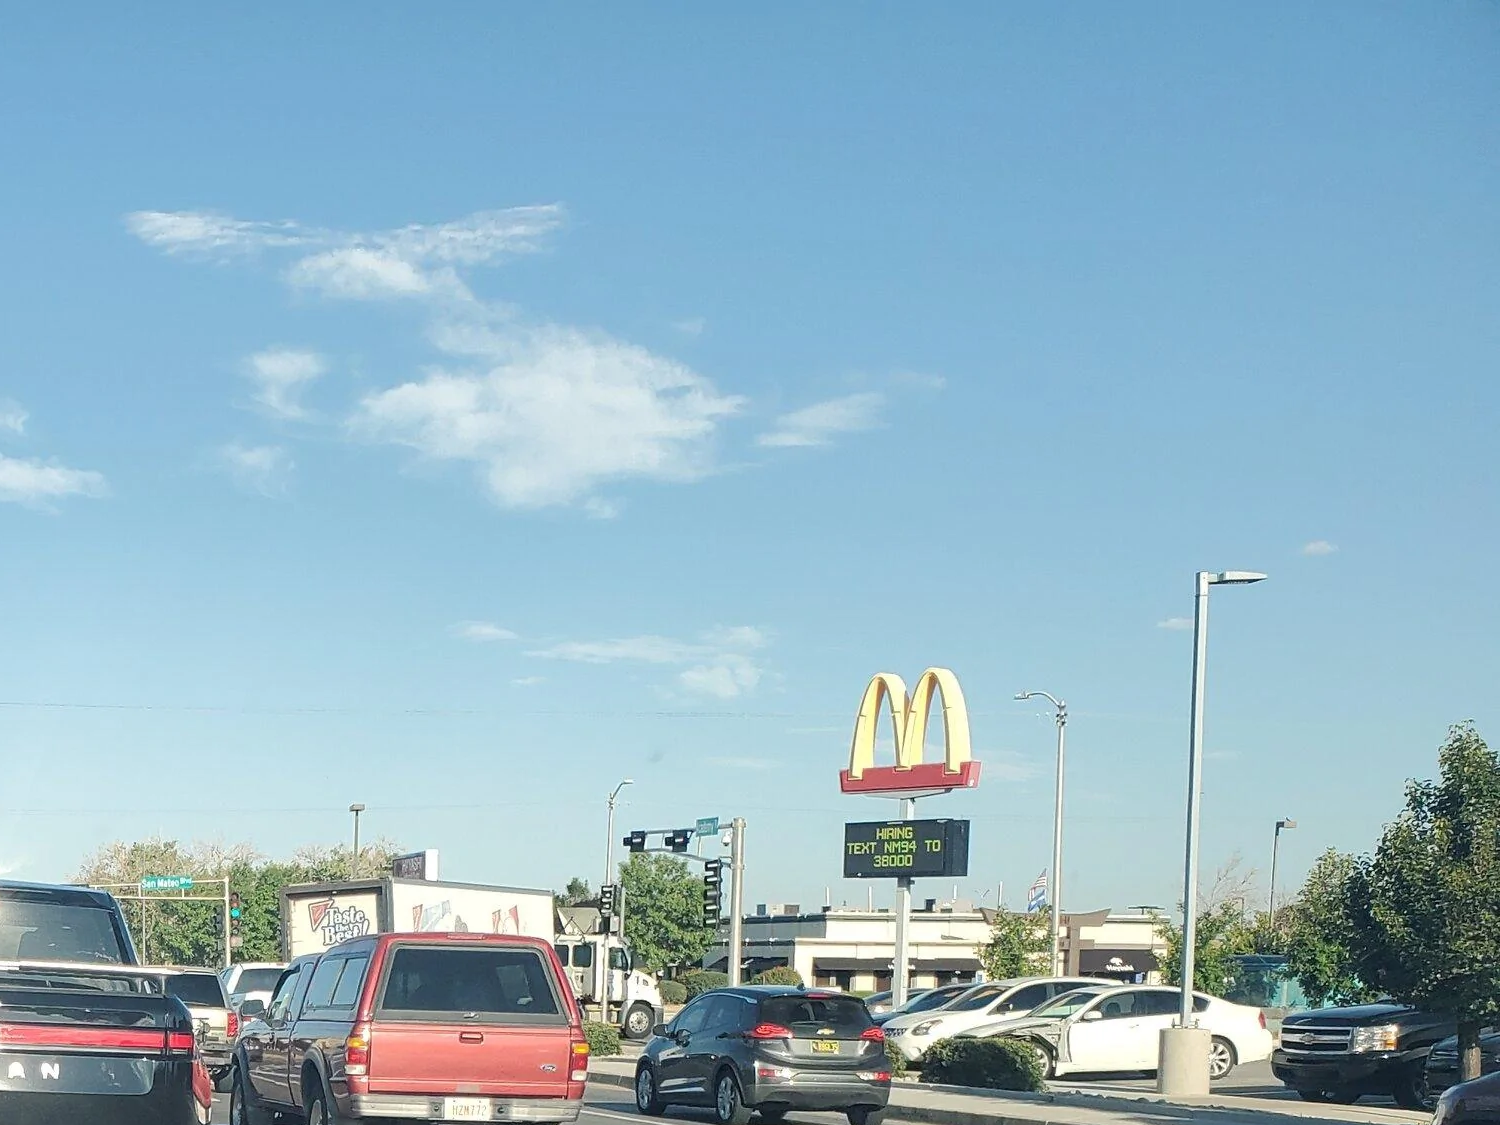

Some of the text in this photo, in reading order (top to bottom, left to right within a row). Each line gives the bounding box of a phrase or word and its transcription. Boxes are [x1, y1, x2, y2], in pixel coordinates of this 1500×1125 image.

[876, 827, 913, 840] HIRING
[846, 839, 941, 855] TEXT NM94 TO
[873, 855, 913, 868] 38000
[141, 879, 157, 889] San
[157, 878, 180, 888] Mateo
[325, 906, 365, 926] Taste
